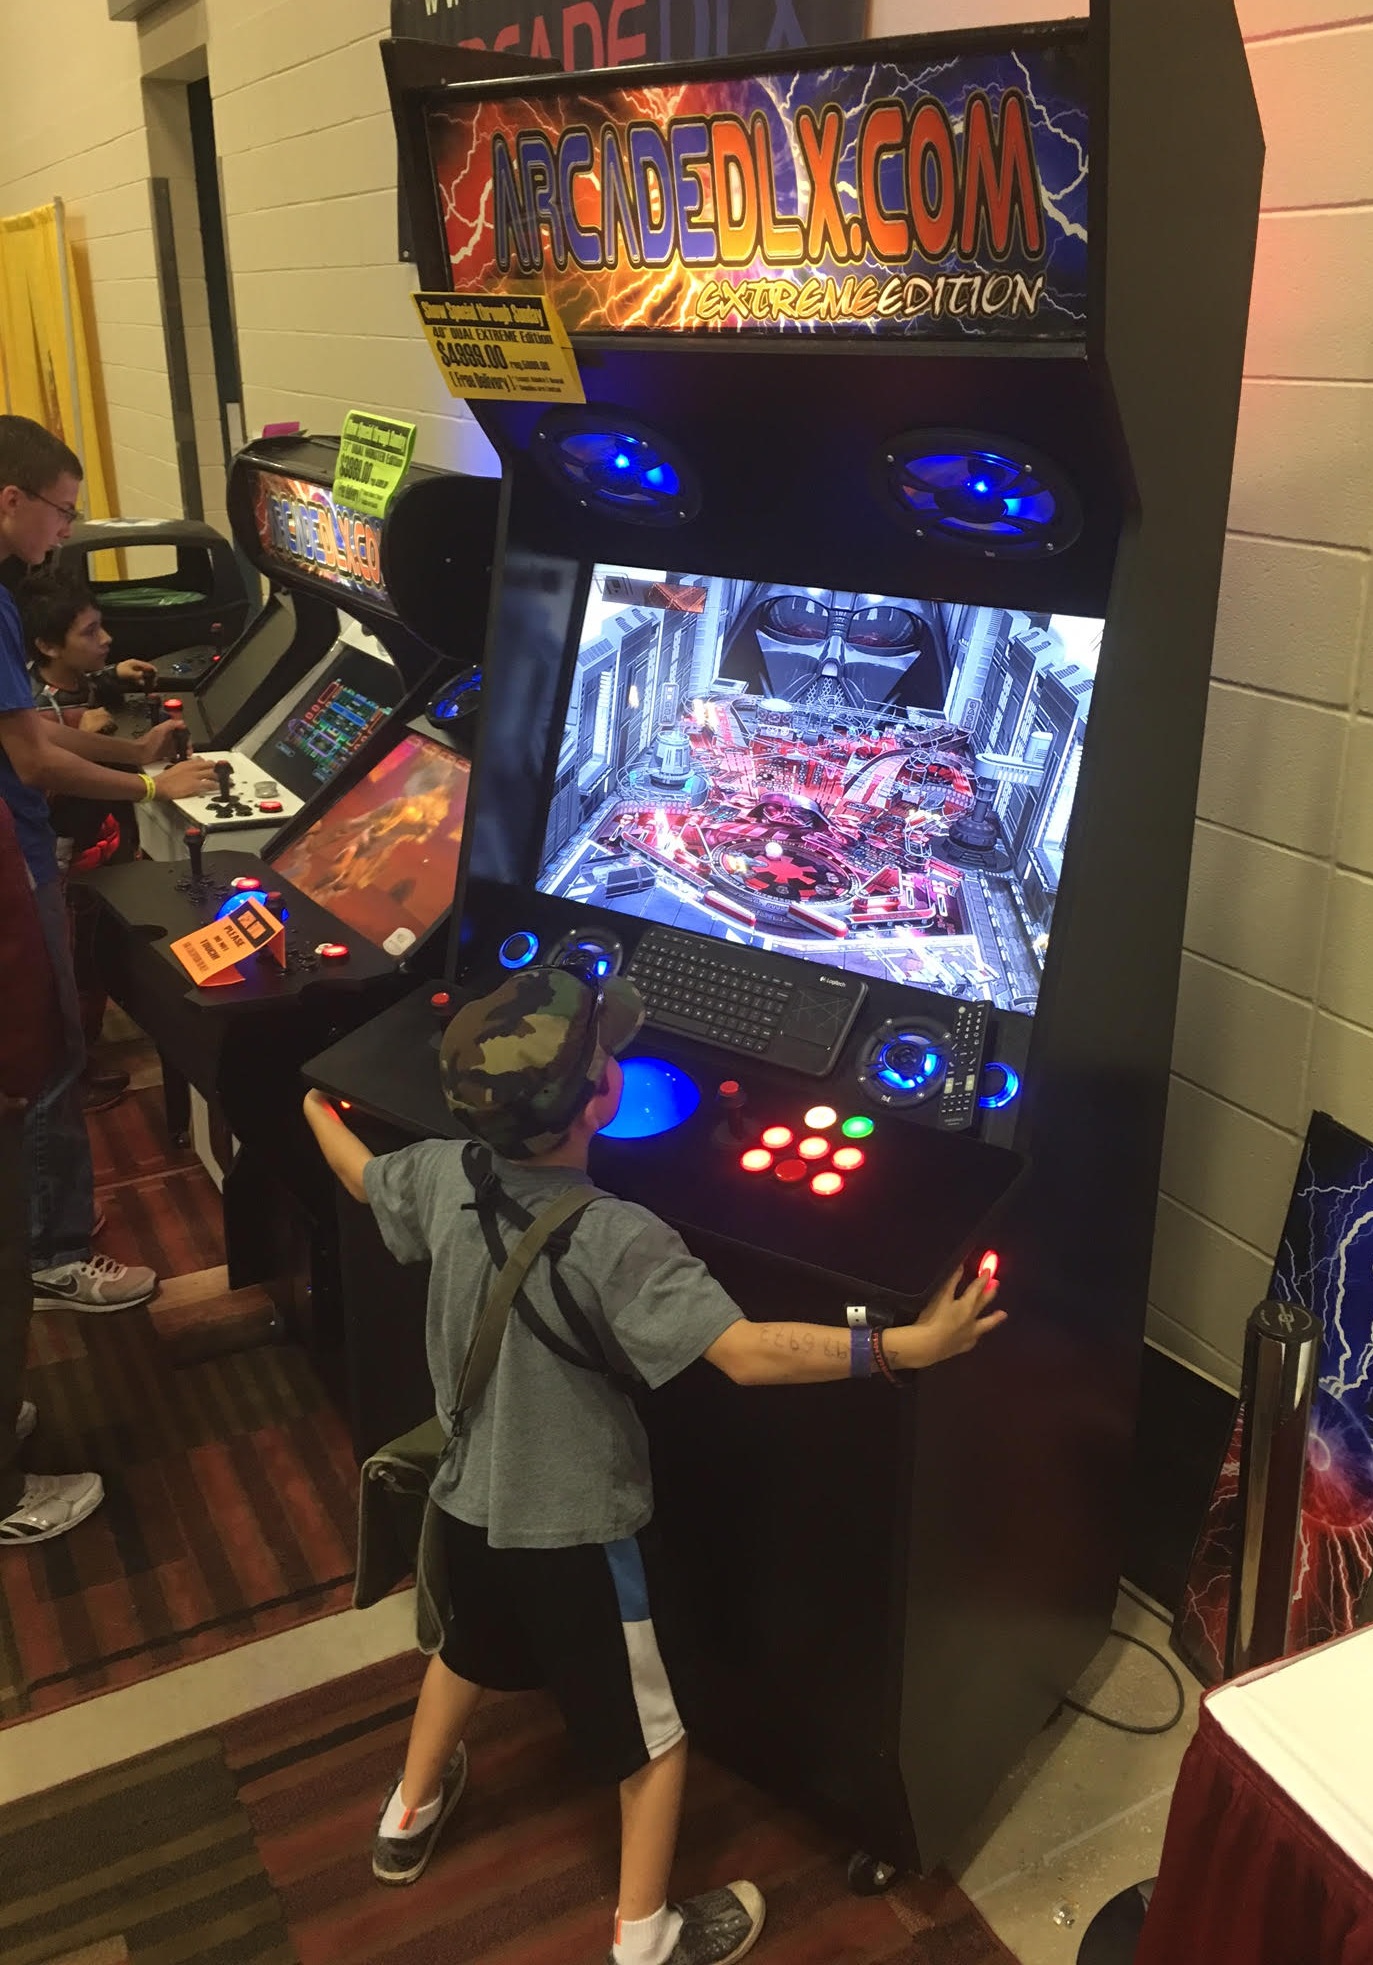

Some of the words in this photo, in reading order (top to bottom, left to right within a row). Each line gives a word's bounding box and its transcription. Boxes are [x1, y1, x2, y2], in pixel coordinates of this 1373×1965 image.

[492, 86, 1046, 274] ARCADEDLX.COM
[449, 327, 475, 340] DUAL
[476, 328, 519, 343] EXTREME
[520, 330, 554, 344] Edition
[436, 340, 509, 370] $4999.00
[223, 924, 246, 948] PLEASE
